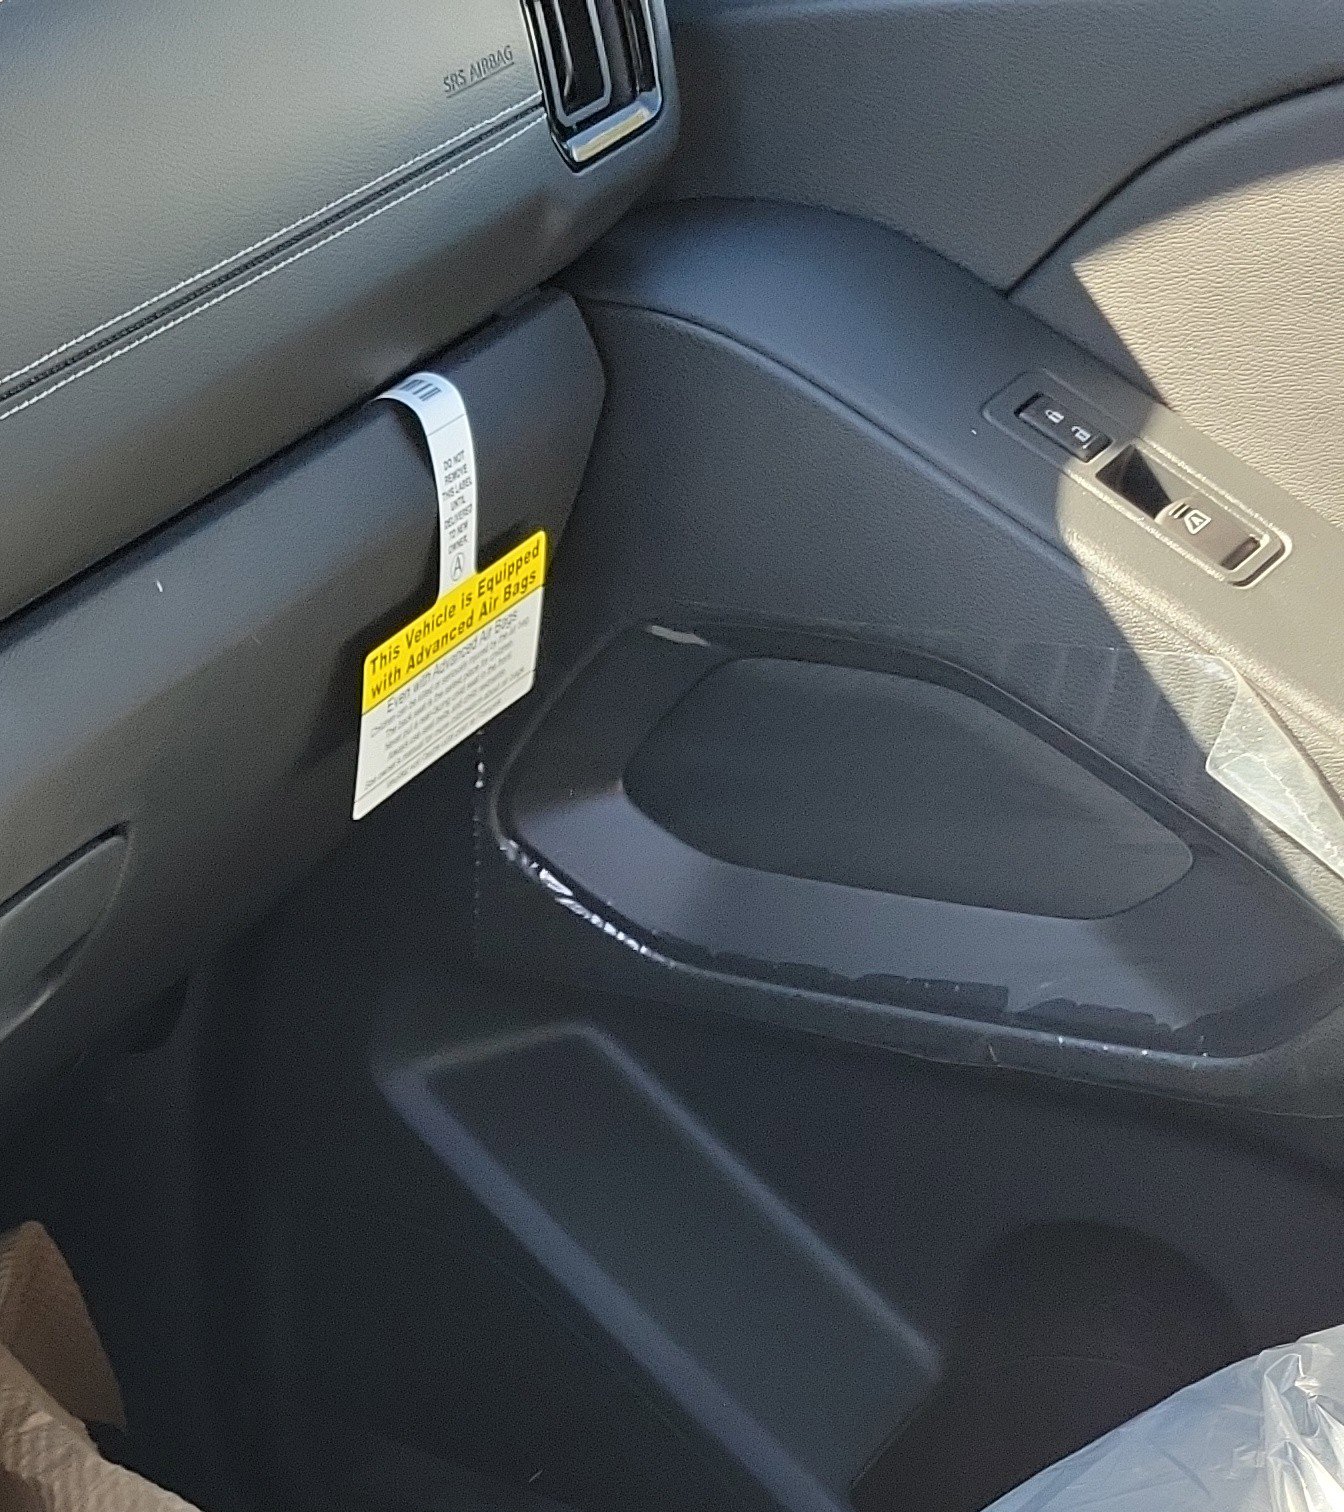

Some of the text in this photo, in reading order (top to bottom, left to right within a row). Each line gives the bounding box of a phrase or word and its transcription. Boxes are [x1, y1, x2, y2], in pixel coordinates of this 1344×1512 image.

[443, 45, 513, 94] SRS AIRBAG
[370, 539, 540, 676] This Vehicle is Equipped
[371, 570, 536, 699] with Advanced Air Bags
